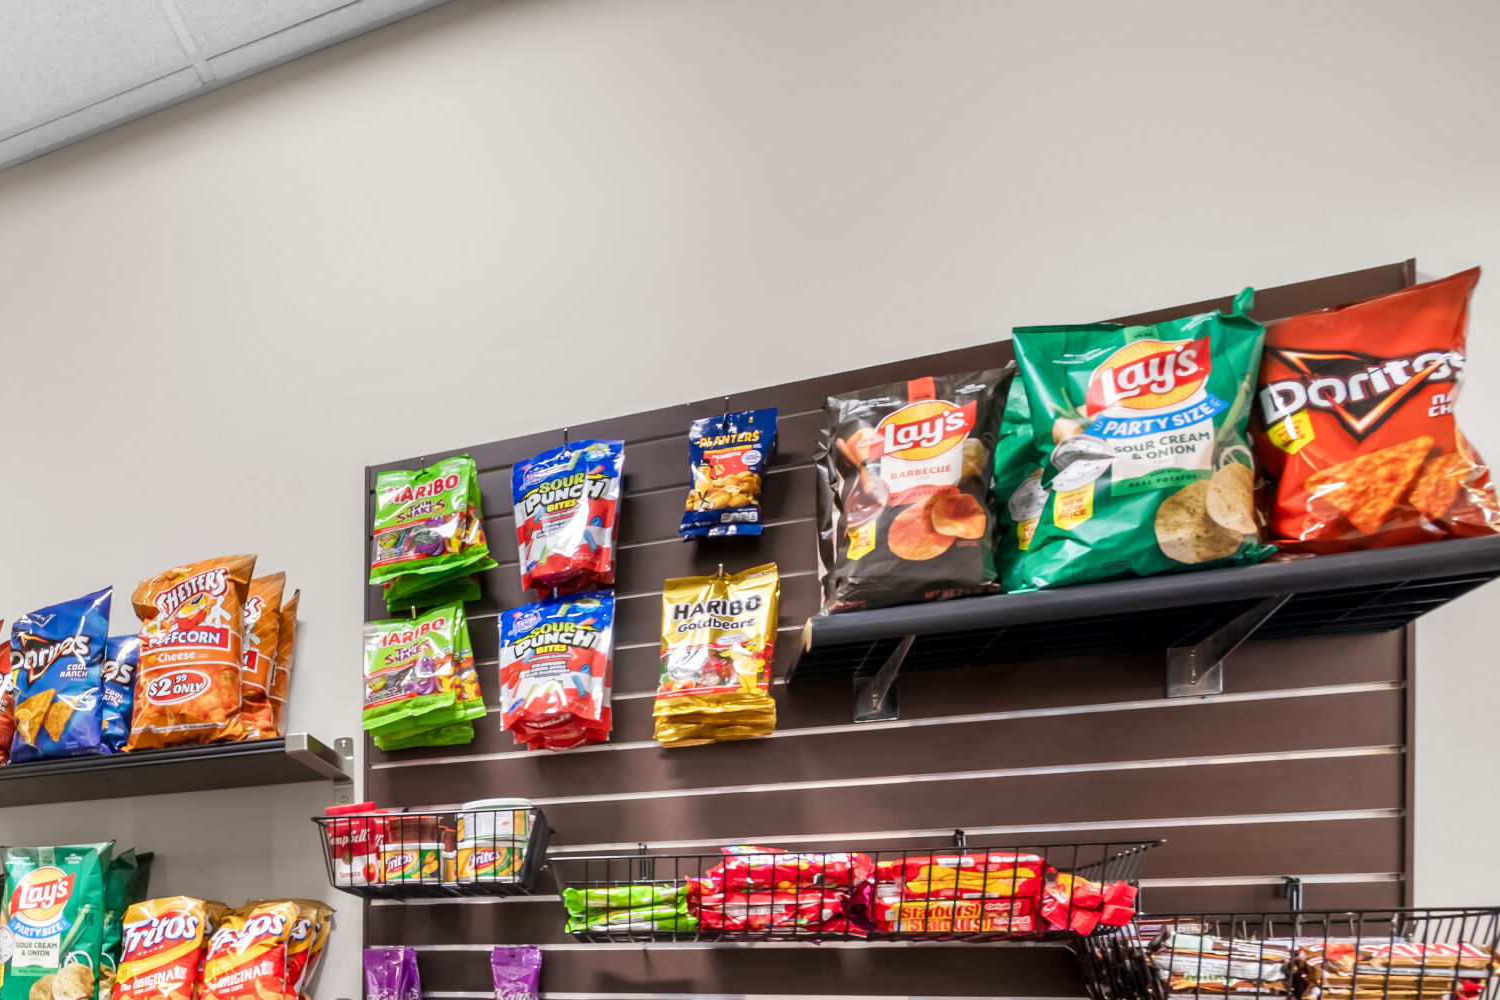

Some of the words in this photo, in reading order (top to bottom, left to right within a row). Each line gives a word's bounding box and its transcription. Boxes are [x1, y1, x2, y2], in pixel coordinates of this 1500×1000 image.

[1101, 345, 1198, 406] Lay's
[1259, 351, 1465, 425] Doritos
[1103, 418, 1171, 436] PARTY
[1172, 403, 1214, 426] SIZE
[699, 431, 760, 448] PLANTERS
[884, 410, 965, 453] Lay's
[1115, 441, 1155, 454] SOUR
[1159, 432, 1210, 446] CREAM
[1132, 453, 1141, 461] &
[1146, 445, 1196, 459] ONION
[890, 464, 952, 480] BARBECUE
[538, 472, 585, 494] SOUR
[525, 477, 612, 516] PUNCH
[546, 499, 577, 512] BITES
[673, 595, 761, 620] HARIBO
[530, 622, 577, 638] SOUR
[678, 618, 754, 632] Goldbears
[513, 630, 596, 659] PUNCH
[535, 644, 568, 655] BITES
[158, 651, 196, 663] Cheese
[60, 670, 88, 678] RANCH
[173, 682, 204, 694] ONLY
[18, 878, 68, 909] Lay's
[14, 923, 42, 938] PARTY
[42, 921, 63, 936] SIZE
[120, 915, 199, 963] Fritos
